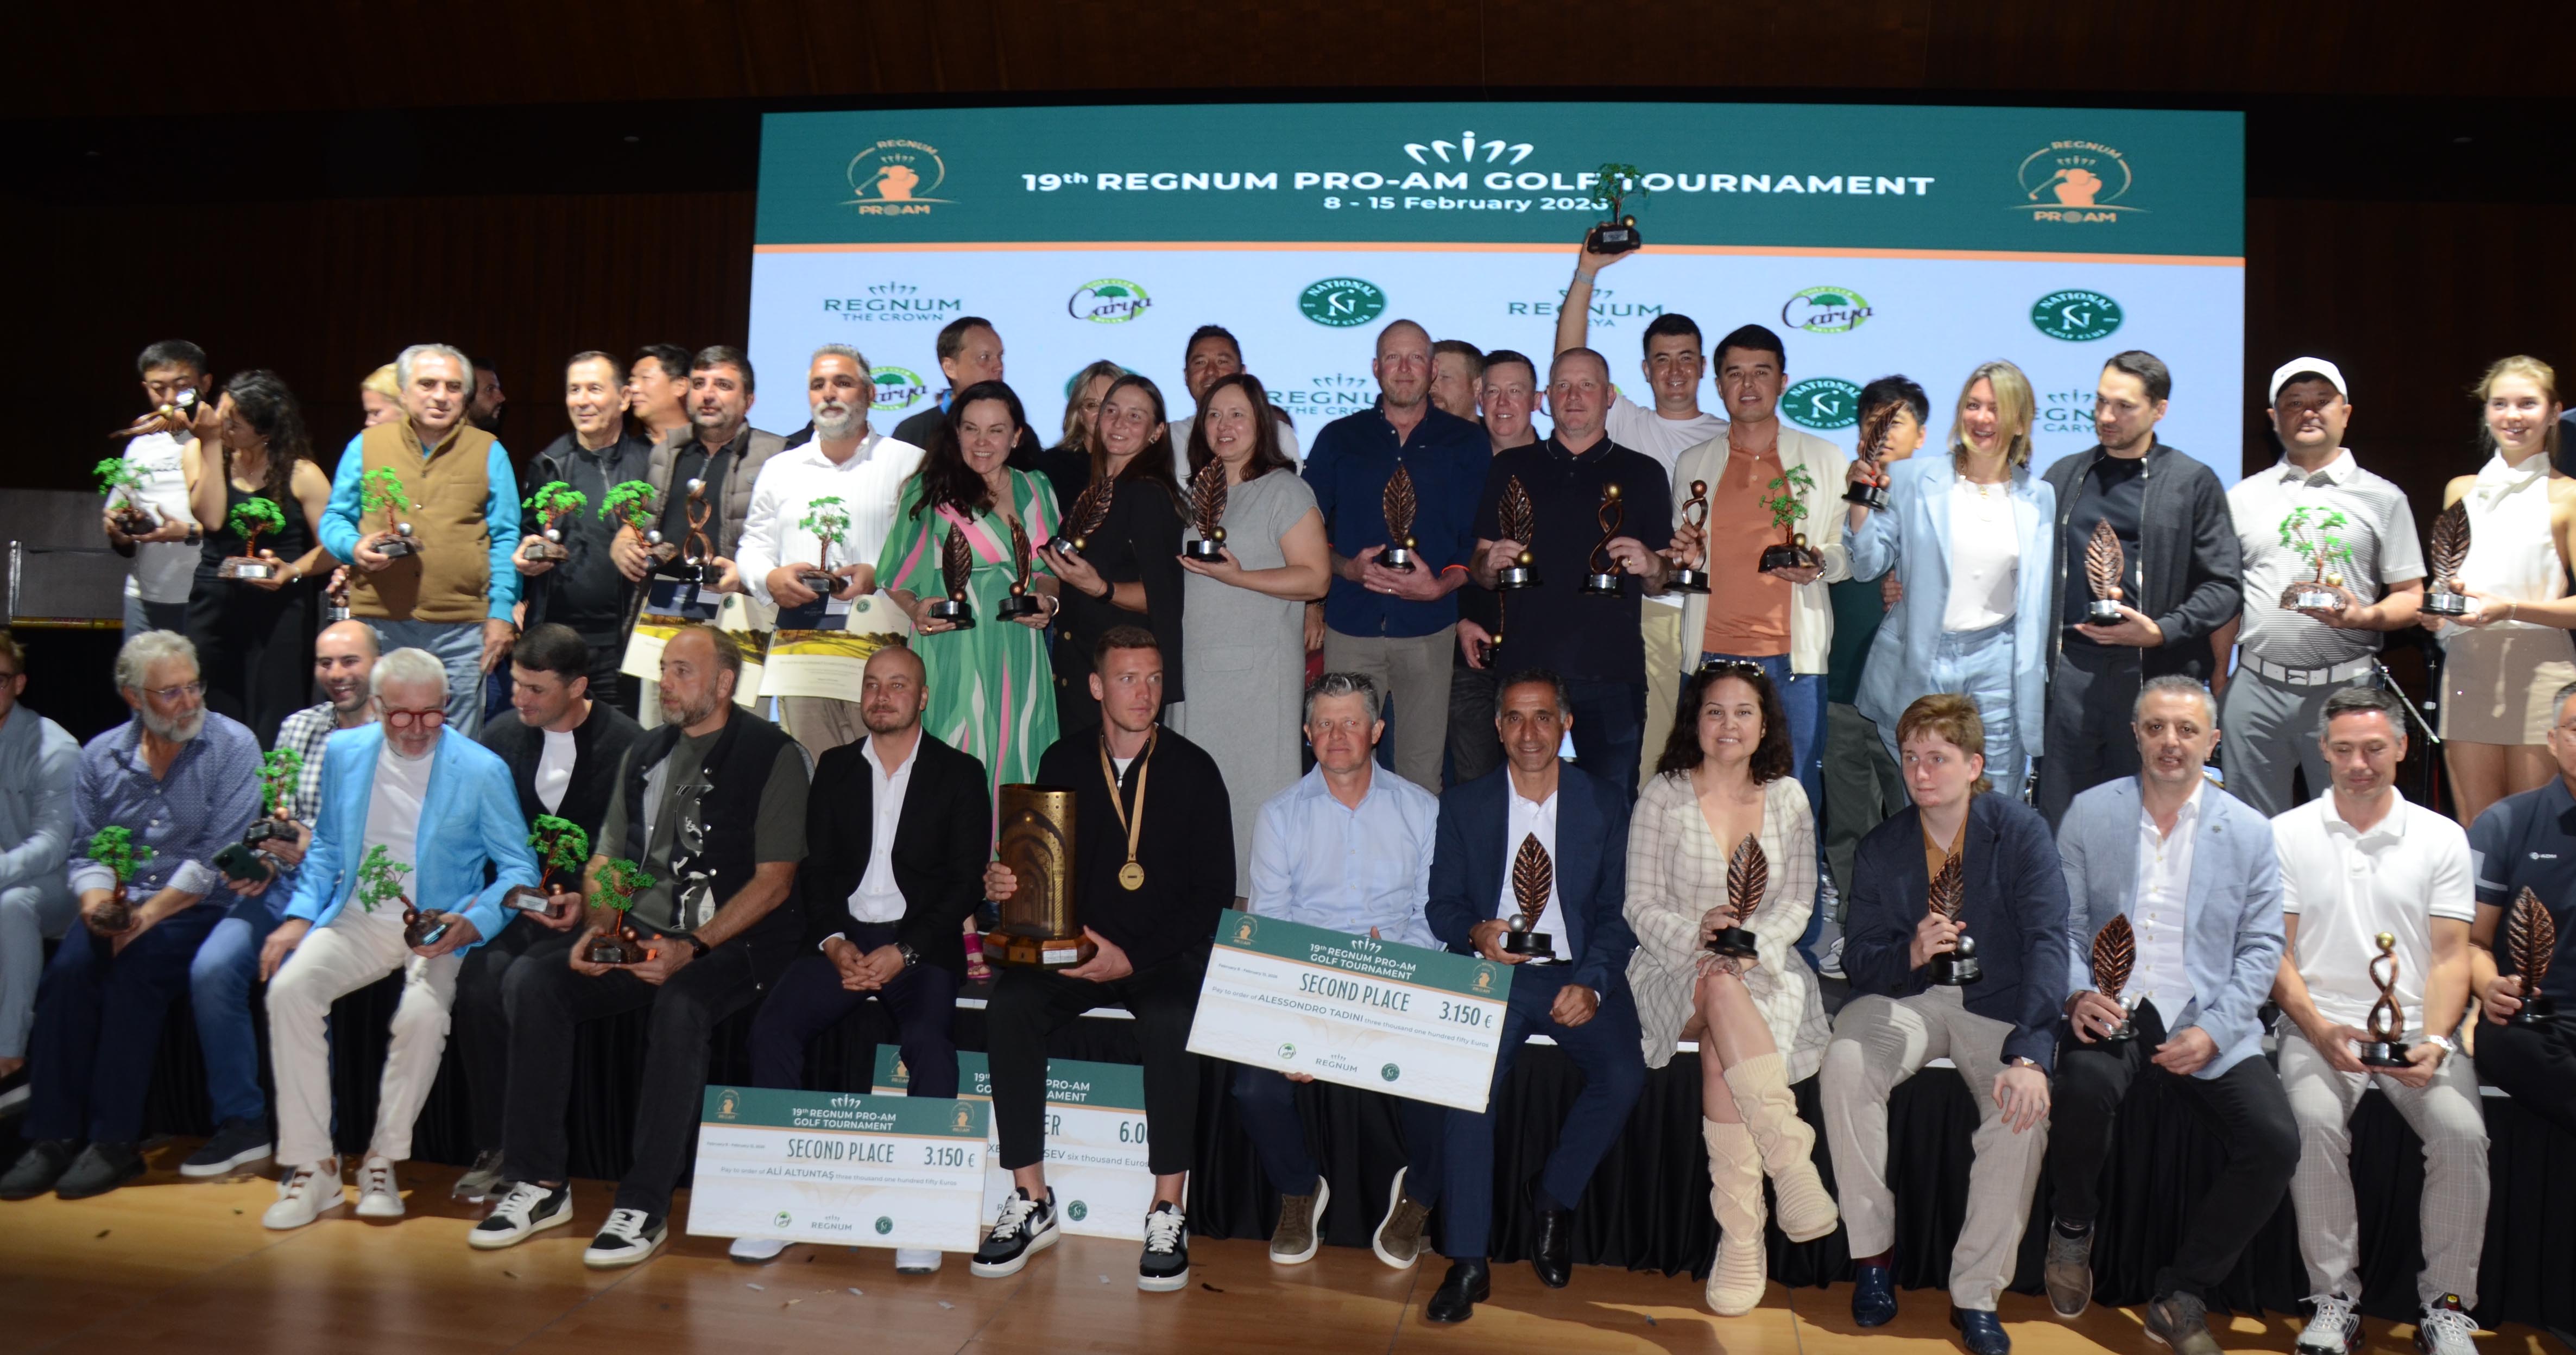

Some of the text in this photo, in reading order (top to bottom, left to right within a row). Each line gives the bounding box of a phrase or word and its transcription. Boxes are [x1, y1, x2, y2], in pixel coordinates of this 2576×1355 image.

[2050, 141, 2122, 159] REGNUM
[1022, 172, 1935, 195] 19th REGNUM PRO-AM GOLF TOURNAMENT
[1324, 197, 1341, 210] 8
[1369, 197, 1396, 210] 15
[1405, 196, 1531, 213] February
[1307, 280, 1376, 297] NATIONAL
[823, 299, 961, 311] REGNUM
[1068, 288, 1153, 320] Carya
[1508, 302, 1664, 316] RENUM
[2039, 292, 2113, 311] NATIONAL
[880, 313, 944, 321] CROWN
[1782, 295, 1876, 331] Carya
[1789, 380, 1862, 398] NATIONAL
[1266, 391, 1375, 405] REGNU
[1325, 406, 1362, 415] CRO
[2043, 423, 2095, 432] CARY
[1310, 944, 1416, 972] 19th REGNUM PRO-AM
[1310, 953, 1412, 980] GOLF TOURNAMENT
[1299, 972, 1411, 1012] SECOND PLACE
[1212, 986, 1223, 994] Pay
[1233, 991, 1249, 999] order
[1258, 994, 1327, 1015] ALESSONDRO
[1330, 1008, 1363, 1022] TADINI
[1365, 1018, 1381, 1026] three
[1383, 1021, 1413, 1033] thousand
[1428, 1031, 1455, 1041] hundred
[1456, 1036, 1469, 1044] fifty
[1471, 1039, 1489, 1048] Euros
[1439, 1001, 1493, 1028] 3.150 €
[1316, 1058, 1358, 1073] REGNUM
[974, 1073, 1090, 1091] 19t PRO-AM
[976, 1084, 992, 1094] GO
[792, 1108, 896, 1122] 19th REGNUM PRO-AM
[794, 1118, 893, 1131] GOLF TOURNAMENT
[787, 1138, 895, 1163] SECOND PLACE
[924, 1146, 976, 1168] 3.150 €
[1081, 1154, 1122, 1165] thousand
[766, 1166, 782, 1175] ALİ
[785, 1168, 835, 1181] ALTUNTAŞ
[811, 1221, 853, 1231] REGNUM
